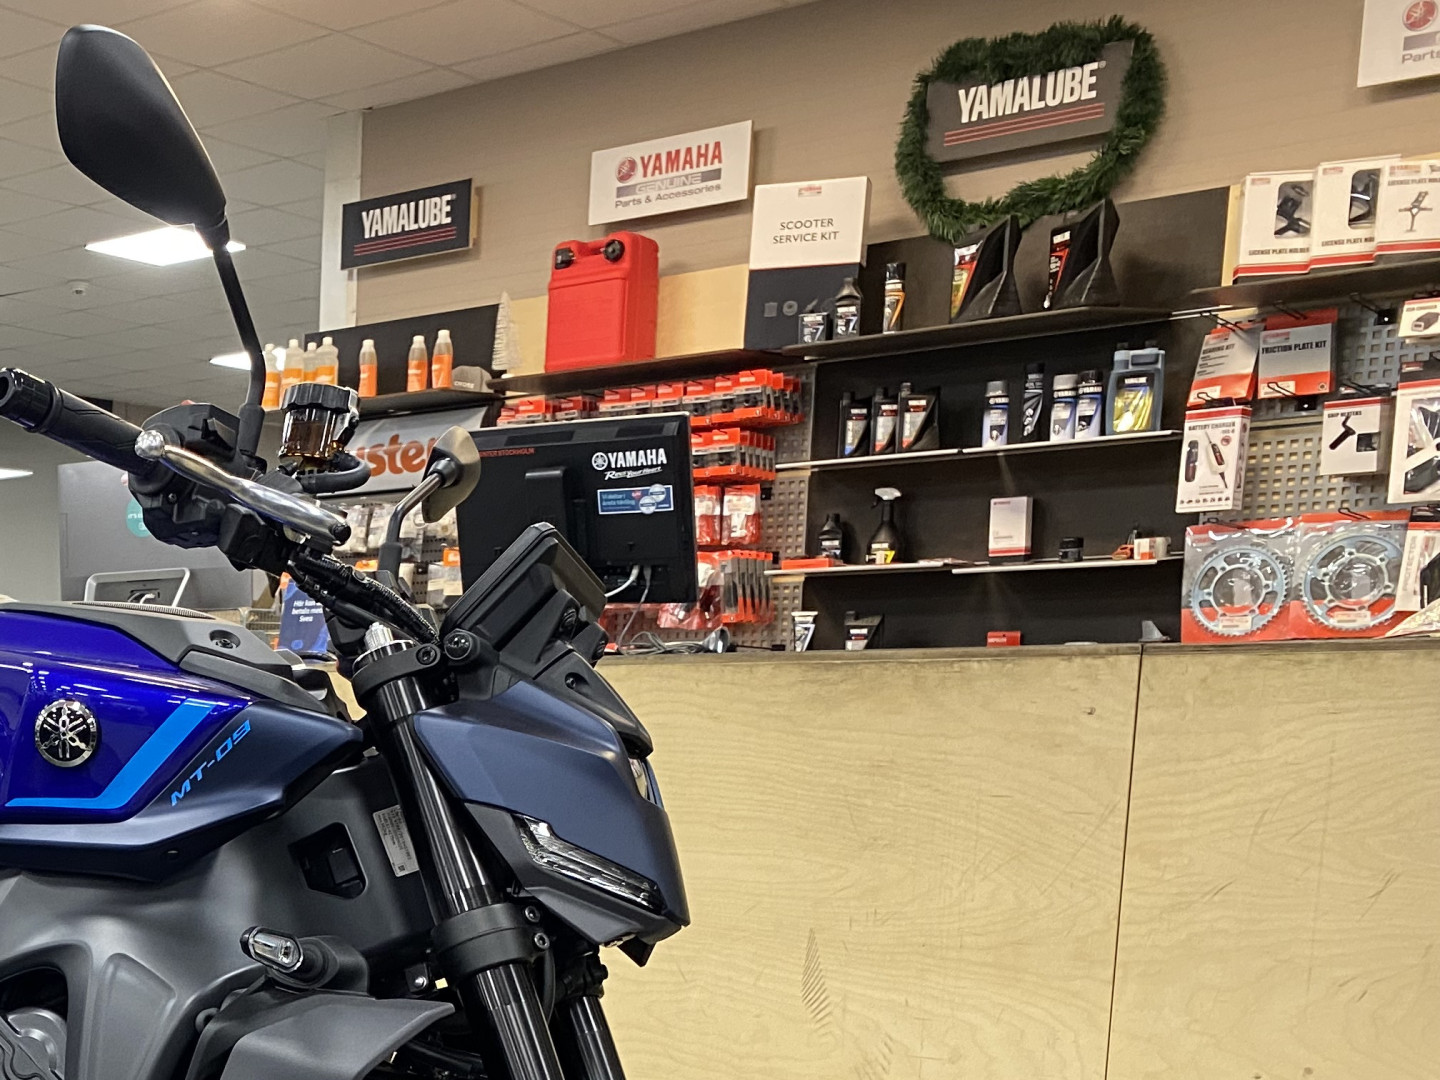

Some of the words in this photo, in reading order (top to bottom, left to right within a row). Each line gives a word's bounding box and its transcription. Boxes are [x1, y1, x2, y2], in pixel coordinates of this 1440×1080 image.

[958, 62, 1099, 123] YAMALUBE
[640, 141, 722, 178] YAMAHA
[635, 172, 702, 194] GENUINE
[615, 198, 642, 208] Parts
[644, 196, 652, 204] &
[655, 184, 721, 202] Accessories
[361, 195, 452, 239] YAMALUBE
[780, 218, 834, 230] SCOOTER
[773, 233, 818, 244] SERVICE
[820, 231, 839, 241] KIT
[1294, 342, 1313, 351] PLATE
[1315, 340, 1327, 349] KIT
[608, 448, 667, 468] YAMAHA
[171, 719, 251, 807] MT-09
